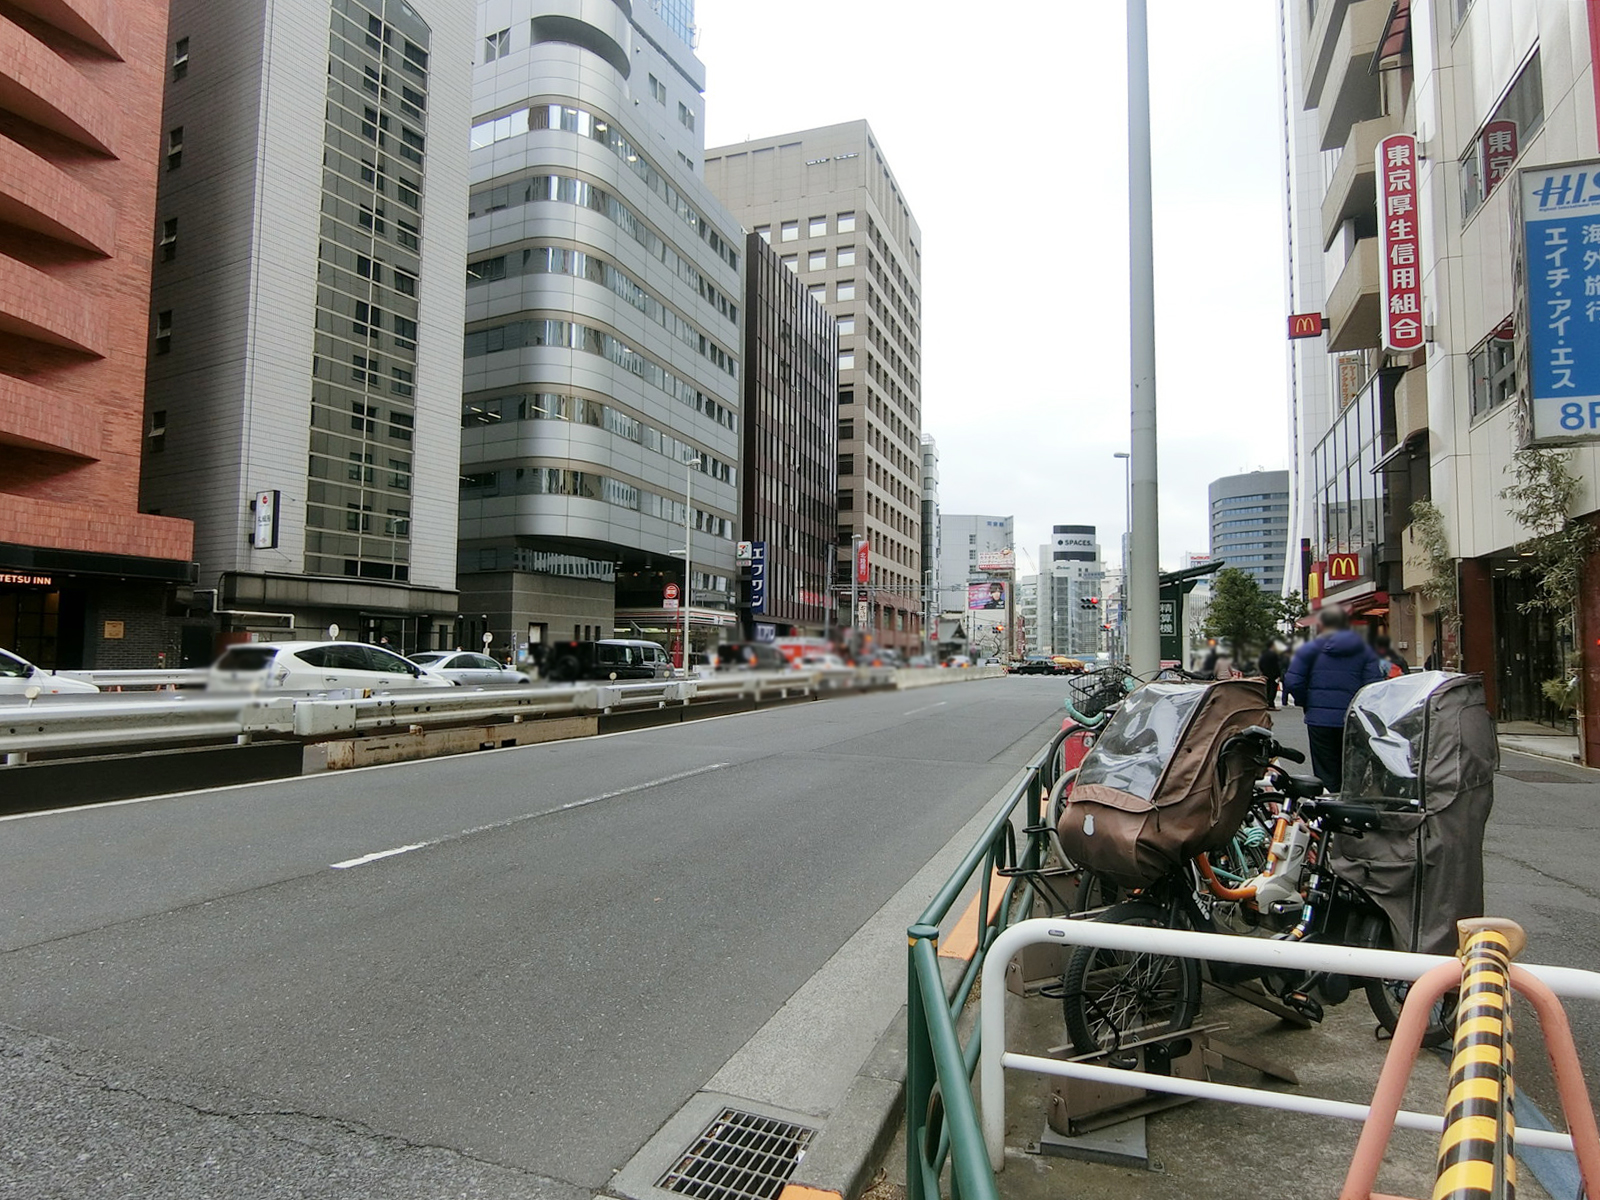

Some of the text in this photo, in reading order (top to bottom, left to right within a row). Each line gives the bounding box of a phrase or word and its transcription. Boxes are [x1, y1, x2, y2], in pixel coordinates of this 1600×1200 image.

[1488, 130, 1513, 187] 東京
[1387, 144, 1419, 339] 東京厚生信用組合
[1544, 227, 1575, 389] エイチ・アイ・エス
[0, 573, 52, 585] TETSU INN
[752, 547, 764, 607] エフワン
[1160, 603, 1173, 634] 精算機
